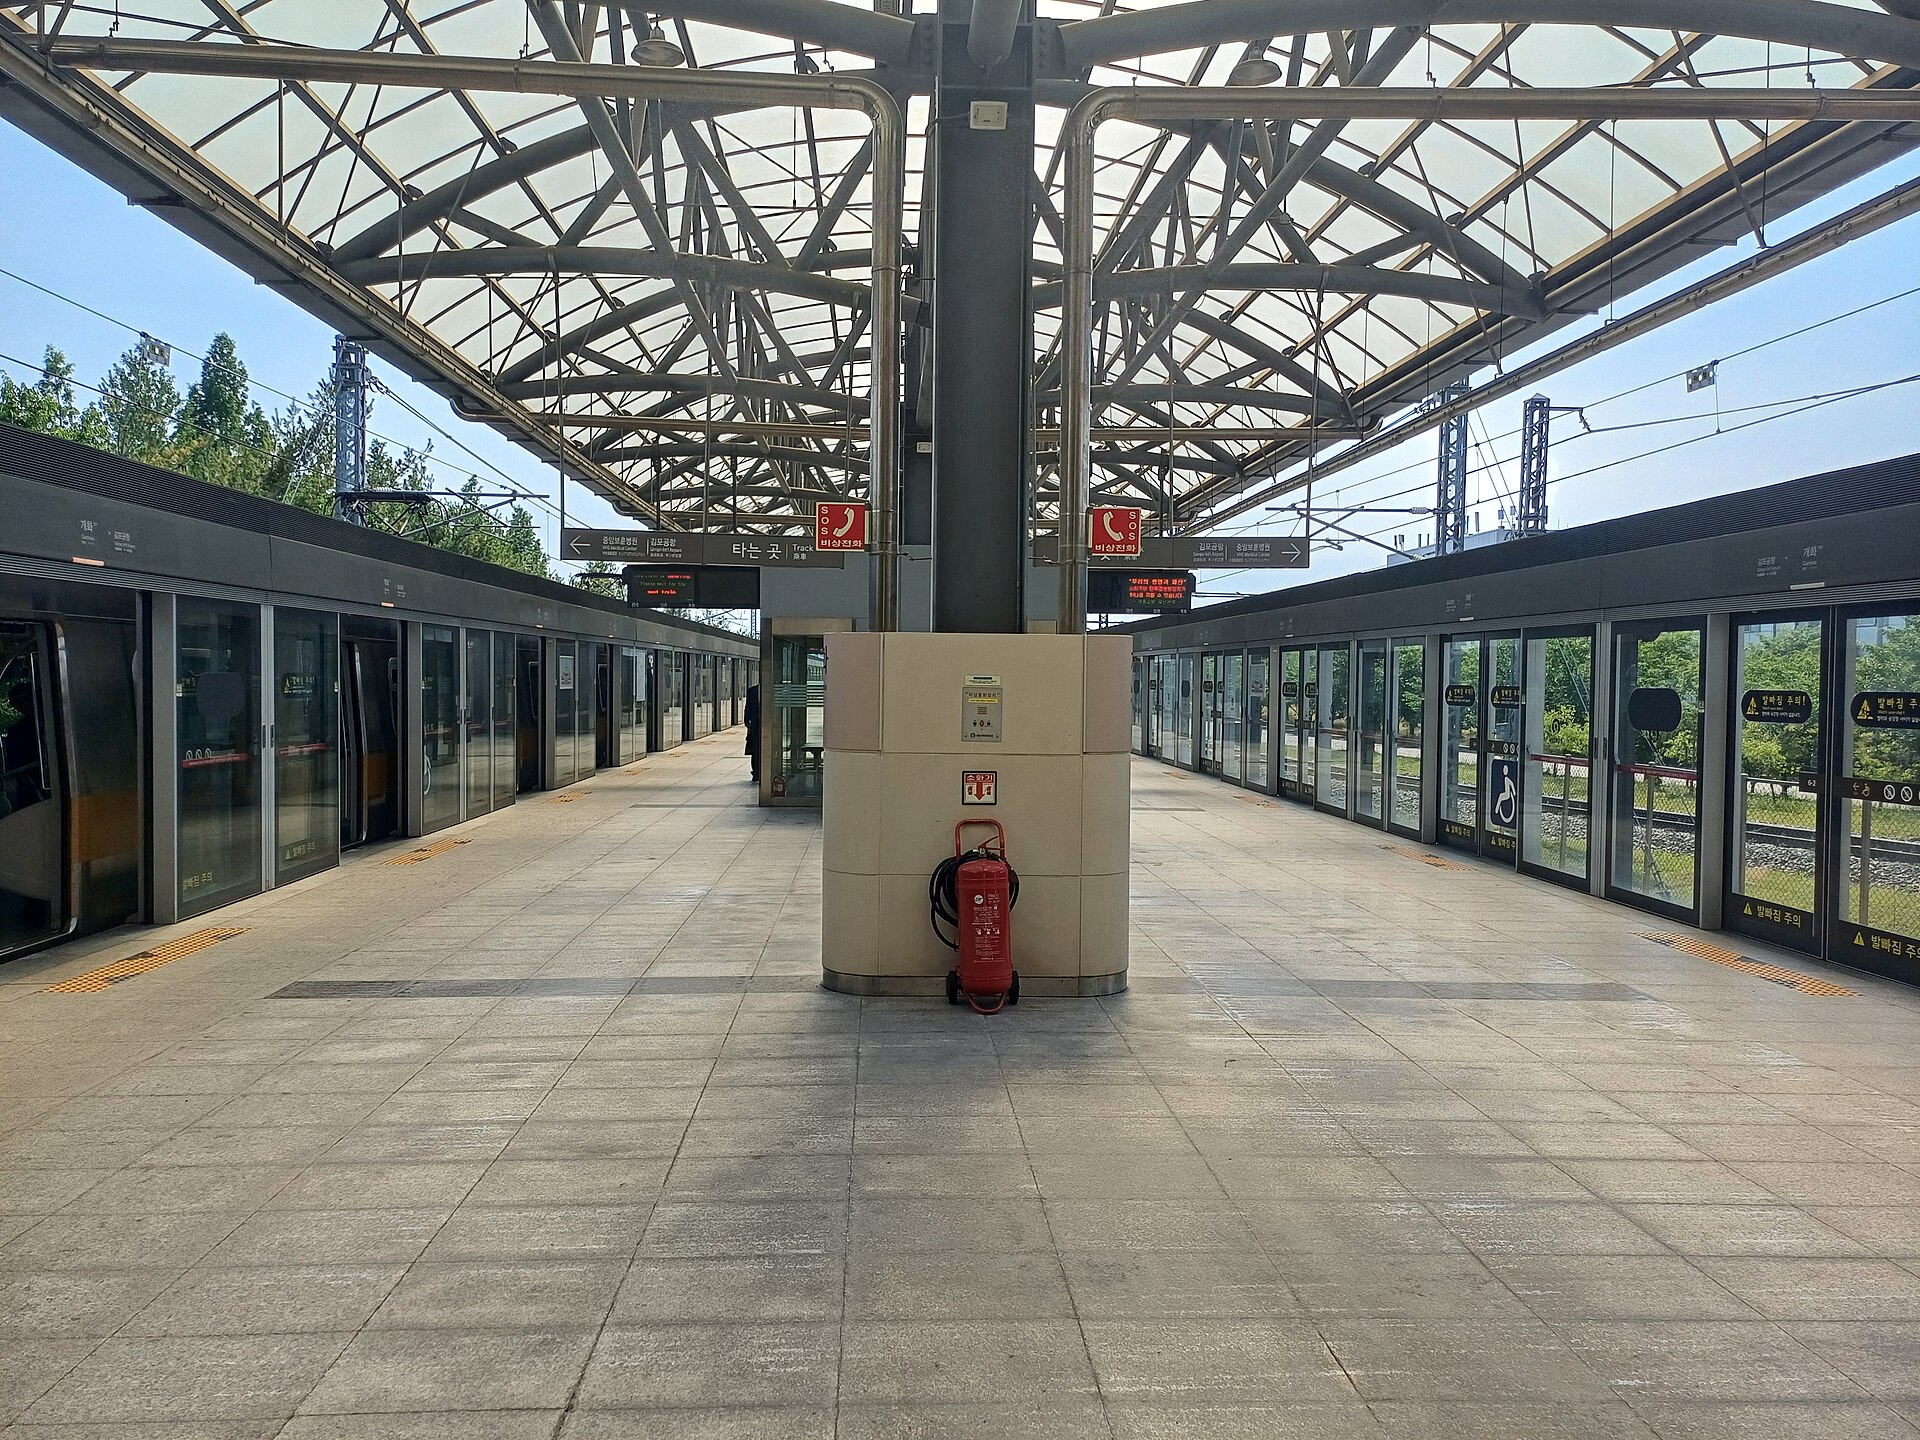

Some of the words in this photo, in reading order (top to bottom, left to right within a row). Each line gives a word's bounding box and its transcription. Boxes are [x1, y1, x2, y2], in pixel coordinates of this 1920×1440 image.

[821, 506, 829, 535] SOS
[1128, 511, 1137, 540] SOS
[602, 536, 638, 546] 중앙보훈병원
[650, 537, 677, 547] 김포공항
[820, 539, 863, 548] 비상전화
[1199, 542, 1224, 551] 김포공항
[732, 542, 762, 559] 타는
[767, 543, 782, 560] 곳
[792, 543, 814, 552] Track
[1095, 543, 1137, 553] 비상전화
[1236, 543, 1271, 552] 중앙보훈병원
[1762, 695, 1783, 707] 발빠짐
[1787, 695, 1806, 706] 주의!
[1877, 697, 1904, 710] 발빠짐
[1909, 698, 1920, 710] 주
[1807, 779, 1817, 787] 6-2
[201, 871, 213, 884] 주의
[1757, 904, 1781, 923] 발빠짐
[1784, 913, 1801, 928] 주의
[1871, 934, 1902, 956] 발빠짐
